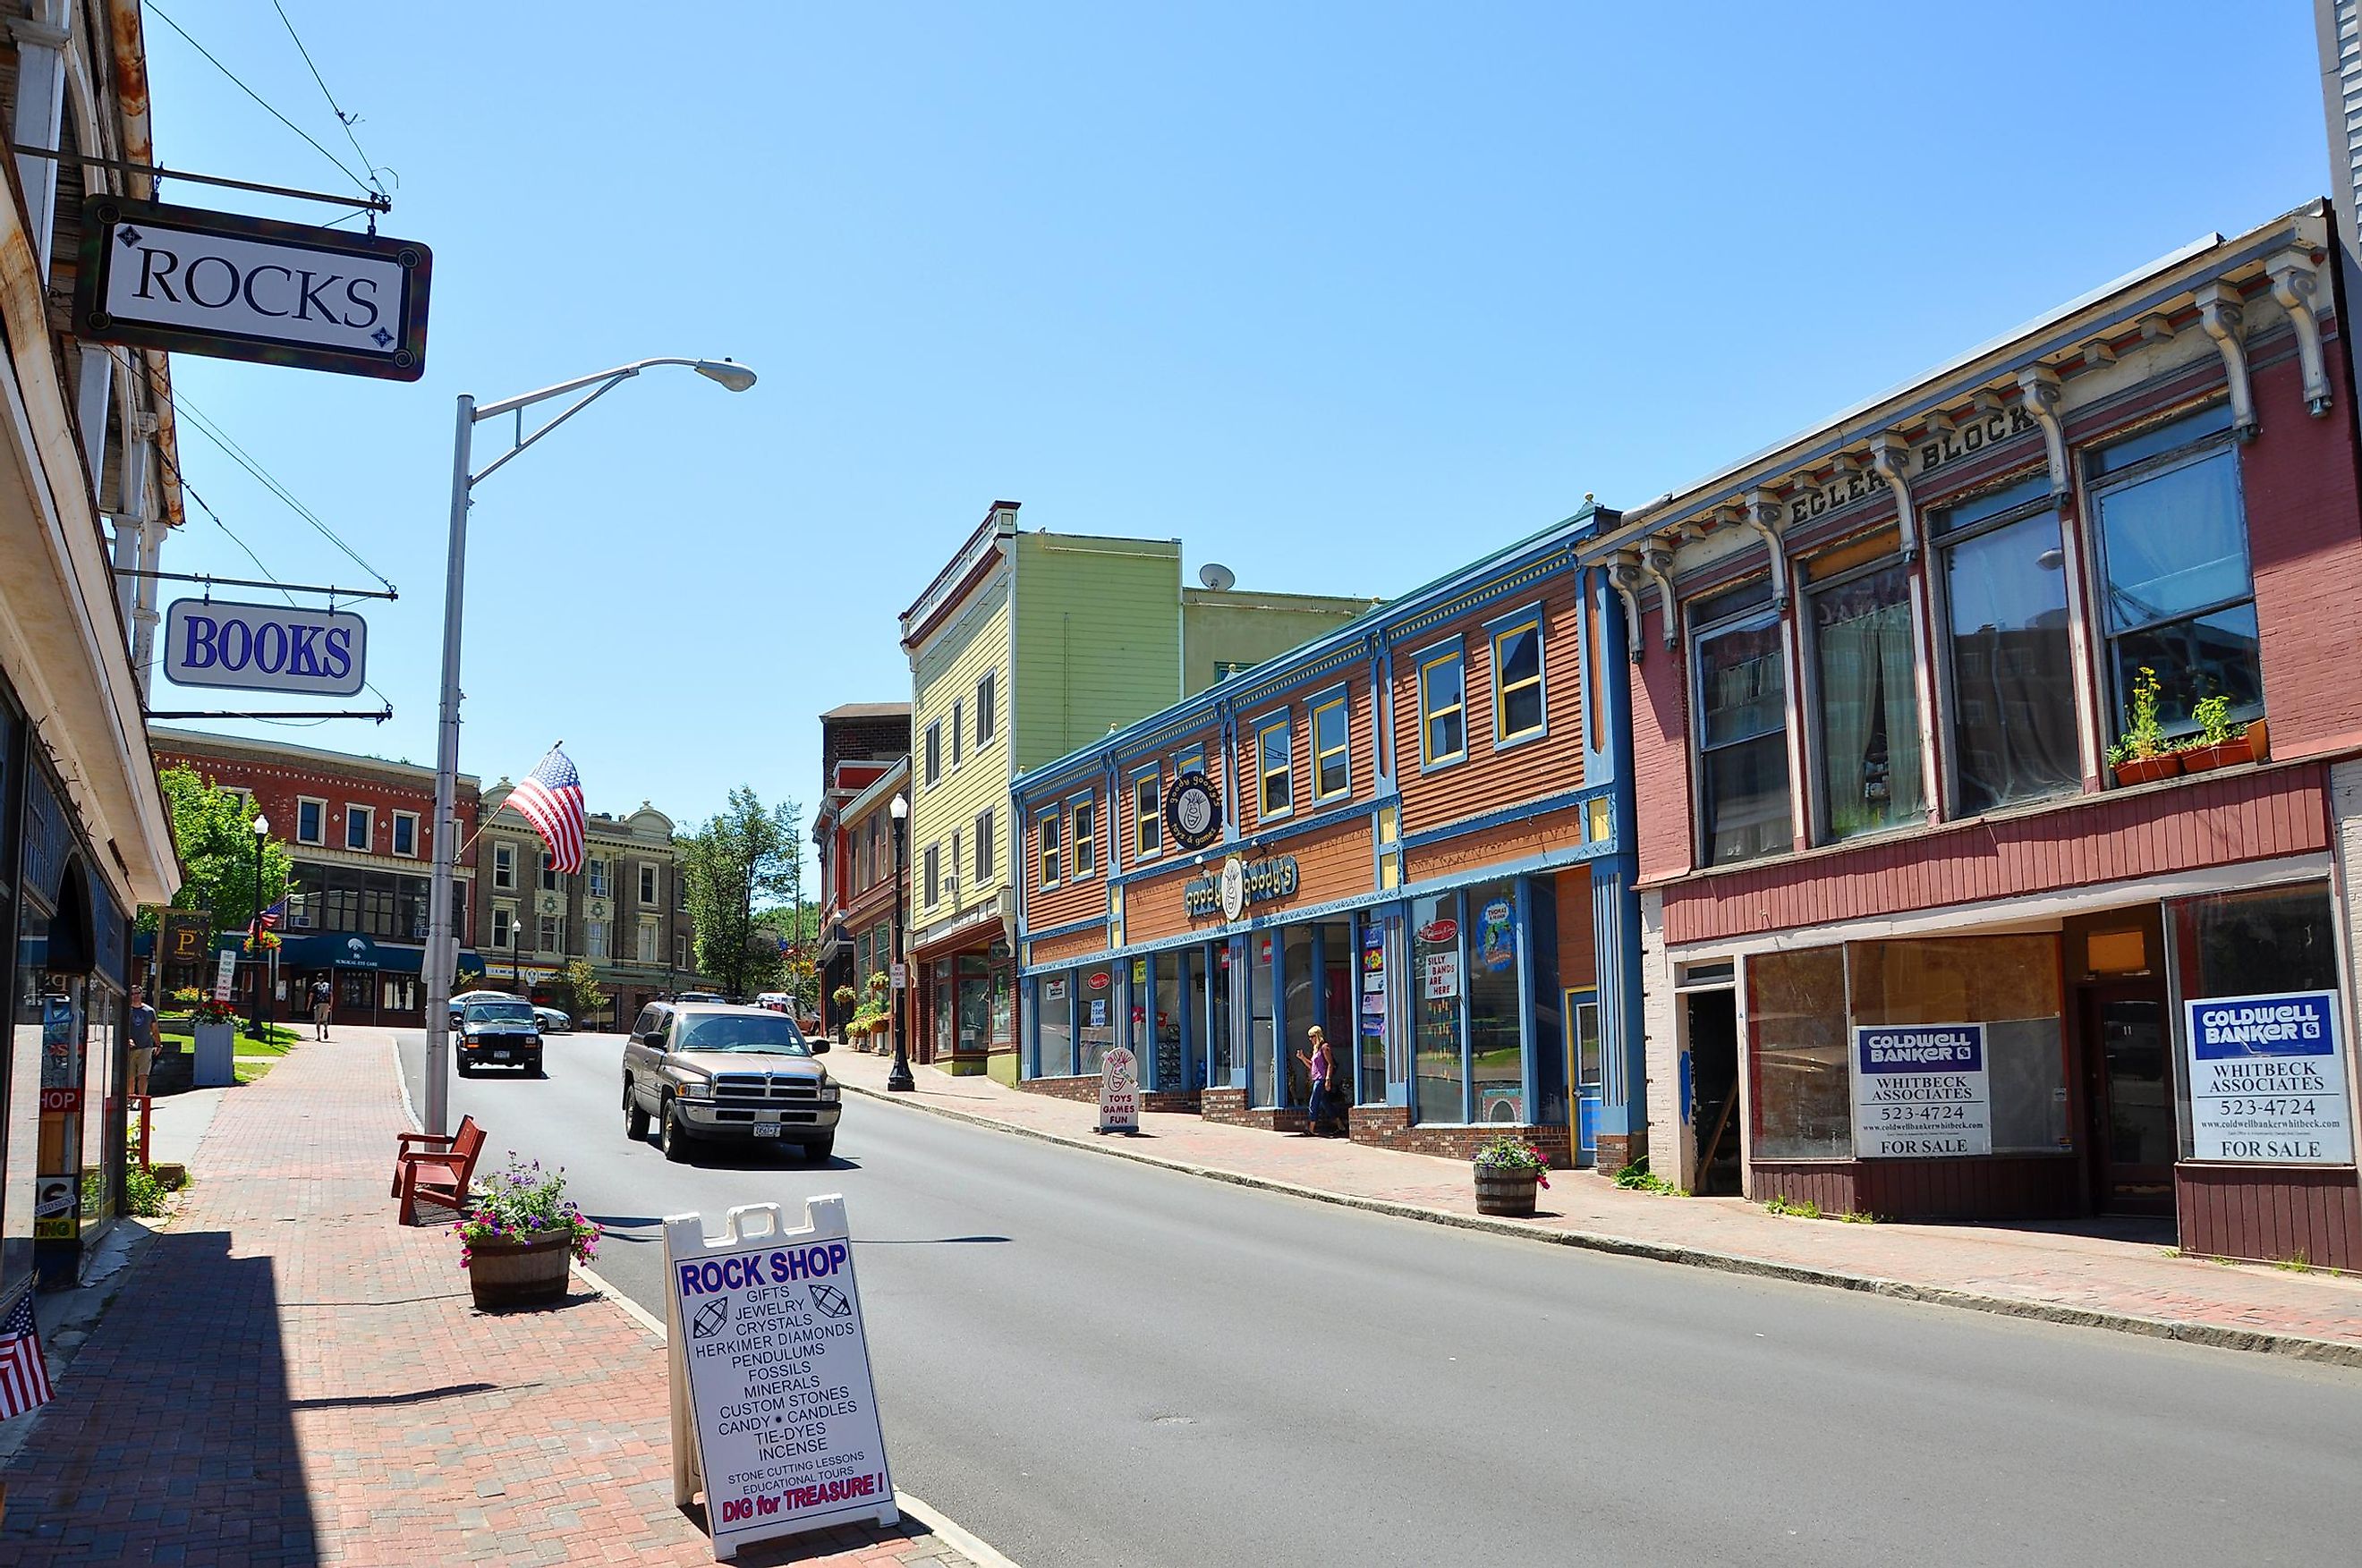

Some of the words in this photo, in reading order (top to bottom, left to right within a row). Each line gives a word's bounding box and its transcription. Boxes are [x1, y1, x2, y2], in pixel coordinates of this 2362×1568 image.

[132, 247, 379, 329] ROCKS
[1921, 404, 2034, 470] BLOCK
[181, 614, 352, 679] BOOKS
[1186, 877, 1221, 918] goody
[1244, 865, 1291, 907] goody's
[177, 933, 195, 952] P
[1428, 955, 1446, 965] SILLY
[1432, 965, 1454, 975] BANDS
[1430, 977, 1441, 985] ARE
[1434, 986, 1449, 995] HERE
[2213, 1063, 2316, 1077] WHITBECK
[1877, 1077, 1967, 1089] WHITBECK
[2209, 1077, 2324, 1093] ASSOCIATES
[1873, 1088, 1972, 1101] ASSOCIATES
[1103, 1106, 1134, 1114] GAMES
[1882, 1106, 1965, 1120] 523-4724
[2220, 1099, 2315, 1115] 523-4724
[2201, 1120, 2340, 1128] www.coldwellbankerwhitbeck.com
[1882, 1140, 1916, 1154] FOR
[1922, 1140, 1967, 1153] SALE
[2222, 1141, 2262, 1157] FOR
[2268, 1141, 2322, 1157] SALE
[681, 1255, 766, 1296] ROCK
[771, 1244, 847, 1284] SHOP
[746, 1285, 790, 1303] GIFTS
[735, 1299, 806, 1320] JEWELRY
[735, 1313, 812, 1336] CRYSTALS
[695, 1336, 773, 1358] HERKIMER
[779, 1322, 854, 1345] DIAMONDS
[732, 1343, 825, 1369] PENDULUMS
[749, 1361, 811, 1382] FOSSILS
[744, 1376, 820, 1398] MINERALS
[720, 1398, 784, 1419] CUSTOM
[789, 1386, 849, 1405] STONES
[718, 1418, 770, 1436] CANDY
[787, 1401, 857, 1423] CANDLES
[754, 1423, 826, 1445] TIE-DYES
[759, 1438, 828, 1461] INCENSE
[728, 1471, 764, 1484] STONE
[767, 1462, 813, 1478] CUTTING
[816, 1451, 864, 1468] LESSONS
[743, 1475, 816, 1495] EDUCATIONAL
[819, 1466, 854, 1483] TOURS
[723, 1499, 752, 1522] DIG
[757, 1494, 780, 1514] for
[784, 1476, 872, 1511] TREASURE
